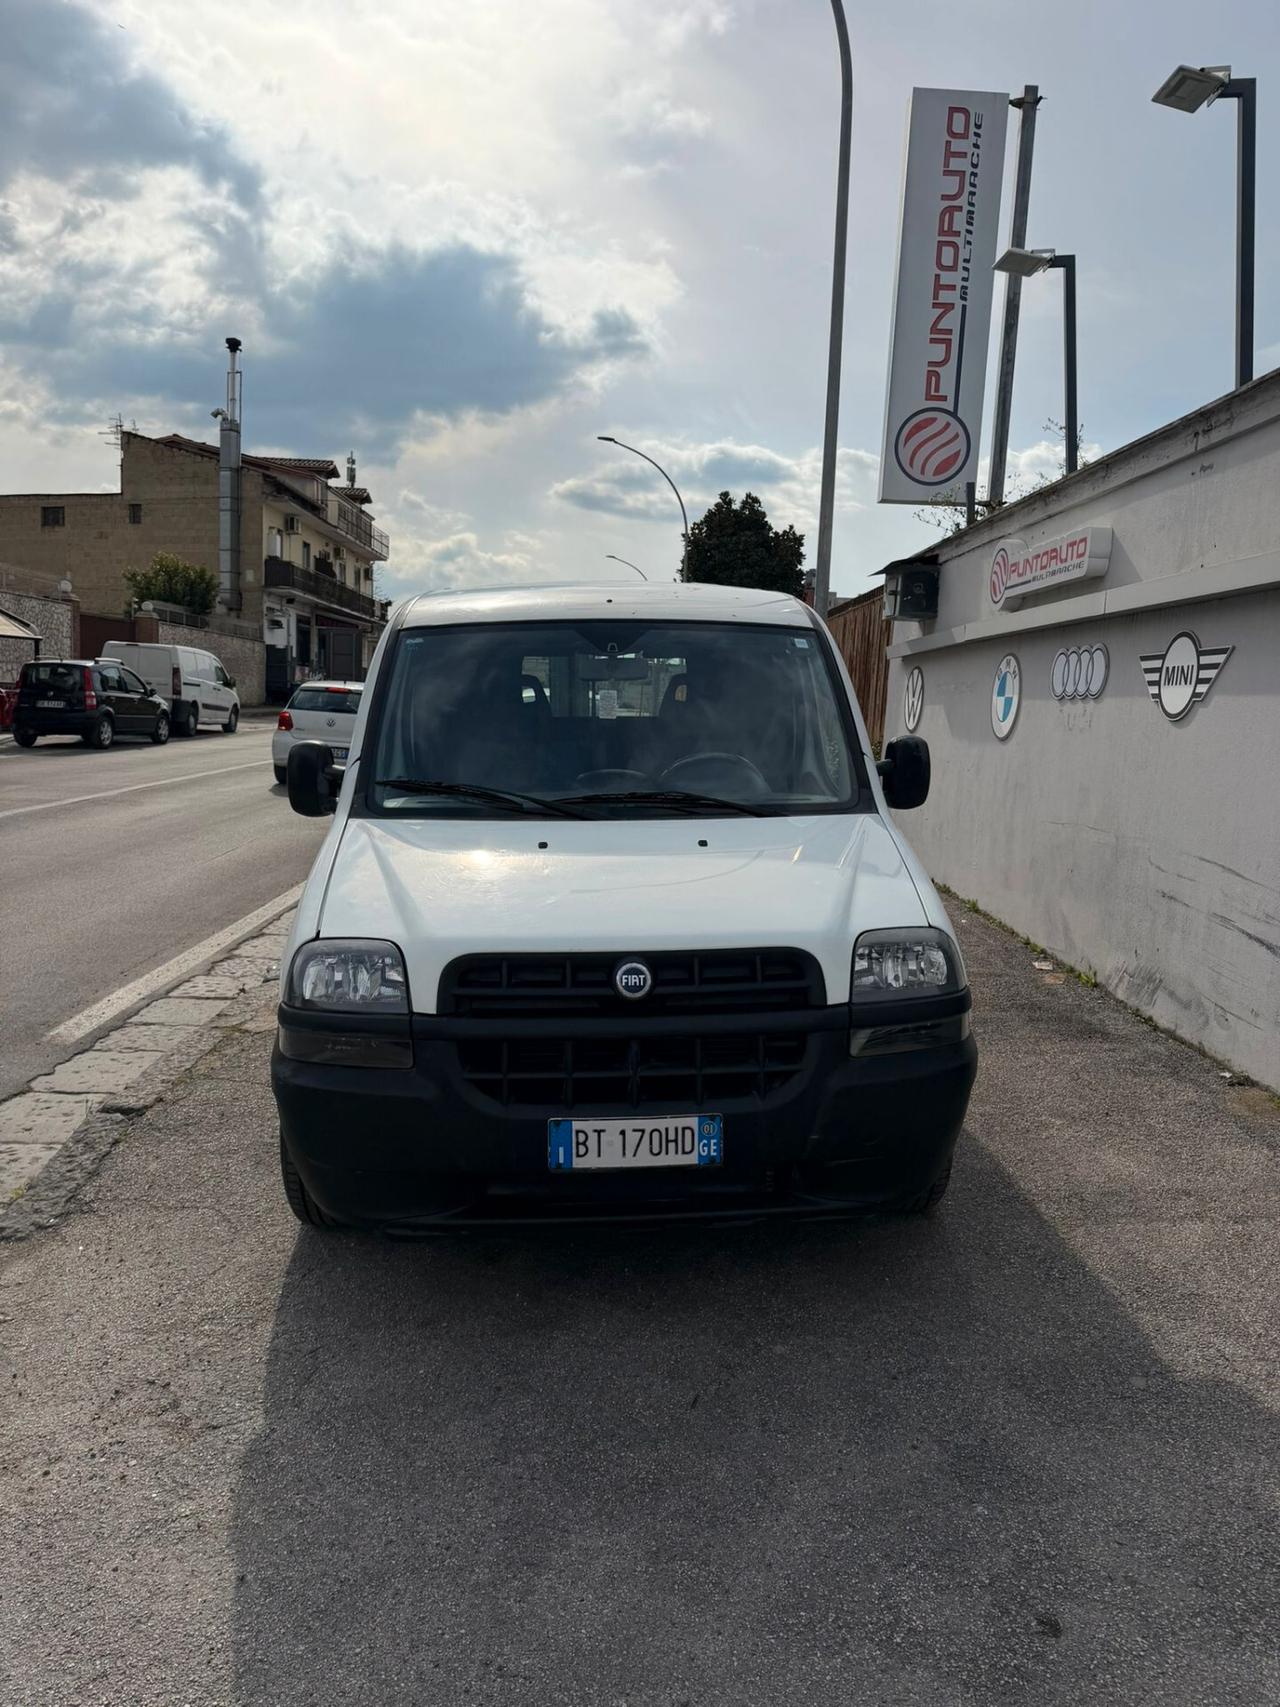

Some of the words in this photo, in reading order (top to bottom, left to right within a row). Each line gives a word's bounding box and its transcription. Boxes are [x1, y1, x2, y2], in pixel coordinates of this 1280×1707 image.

[960, 111, 984, 302] MULTIMARCHE
[925, 105, 971, 402] PUNTOAUTO
[1009, 536, 1088, 580] PUNTOAUTO
[1163, 664, 1194, 686] MINI
[622, 974, 646, 986] FIAT
[575, 1128, 606, 1158] BT
[619, 1126, 695, 1158] 170HD
[700, 1139, 718, 1156] GE
